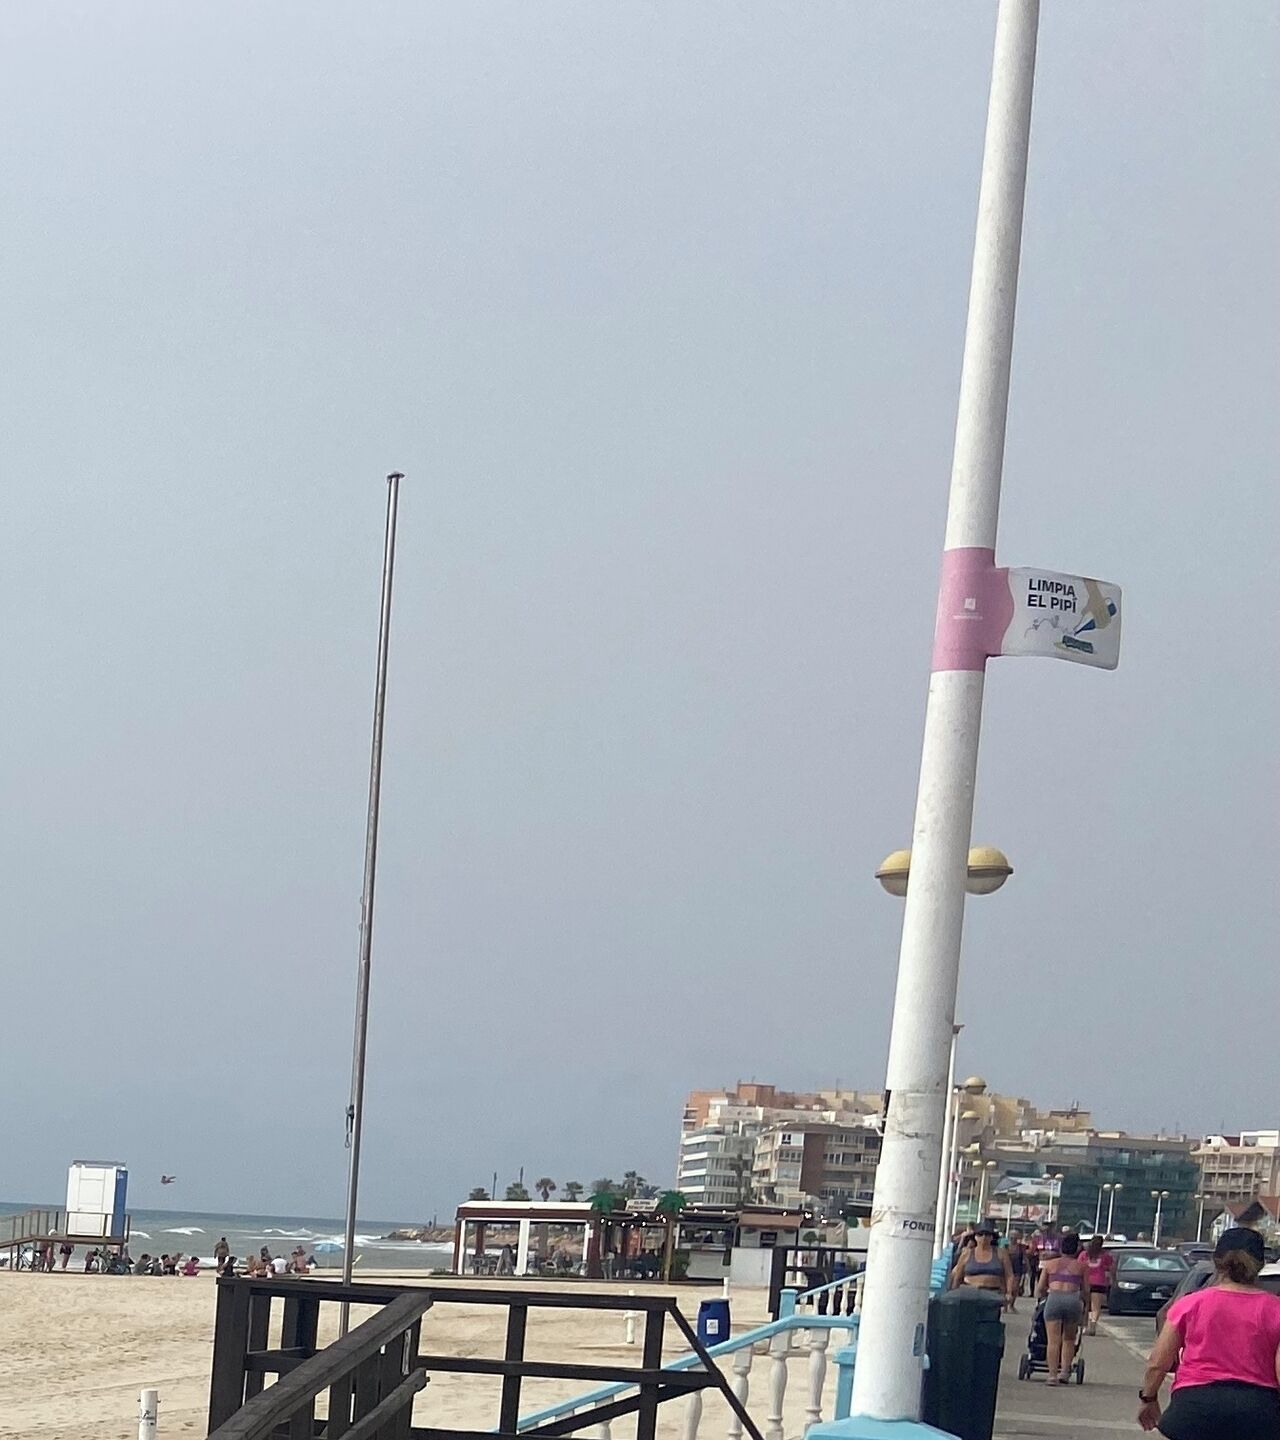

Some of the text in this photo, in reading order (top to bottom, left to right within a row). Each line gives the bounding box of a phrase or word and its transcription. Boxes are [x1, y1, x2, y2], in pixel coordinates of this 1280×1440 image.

[1028, 578, 1076, 597] LIMPIA
[1027, 593, 1078, 613] EL PIPÍ
